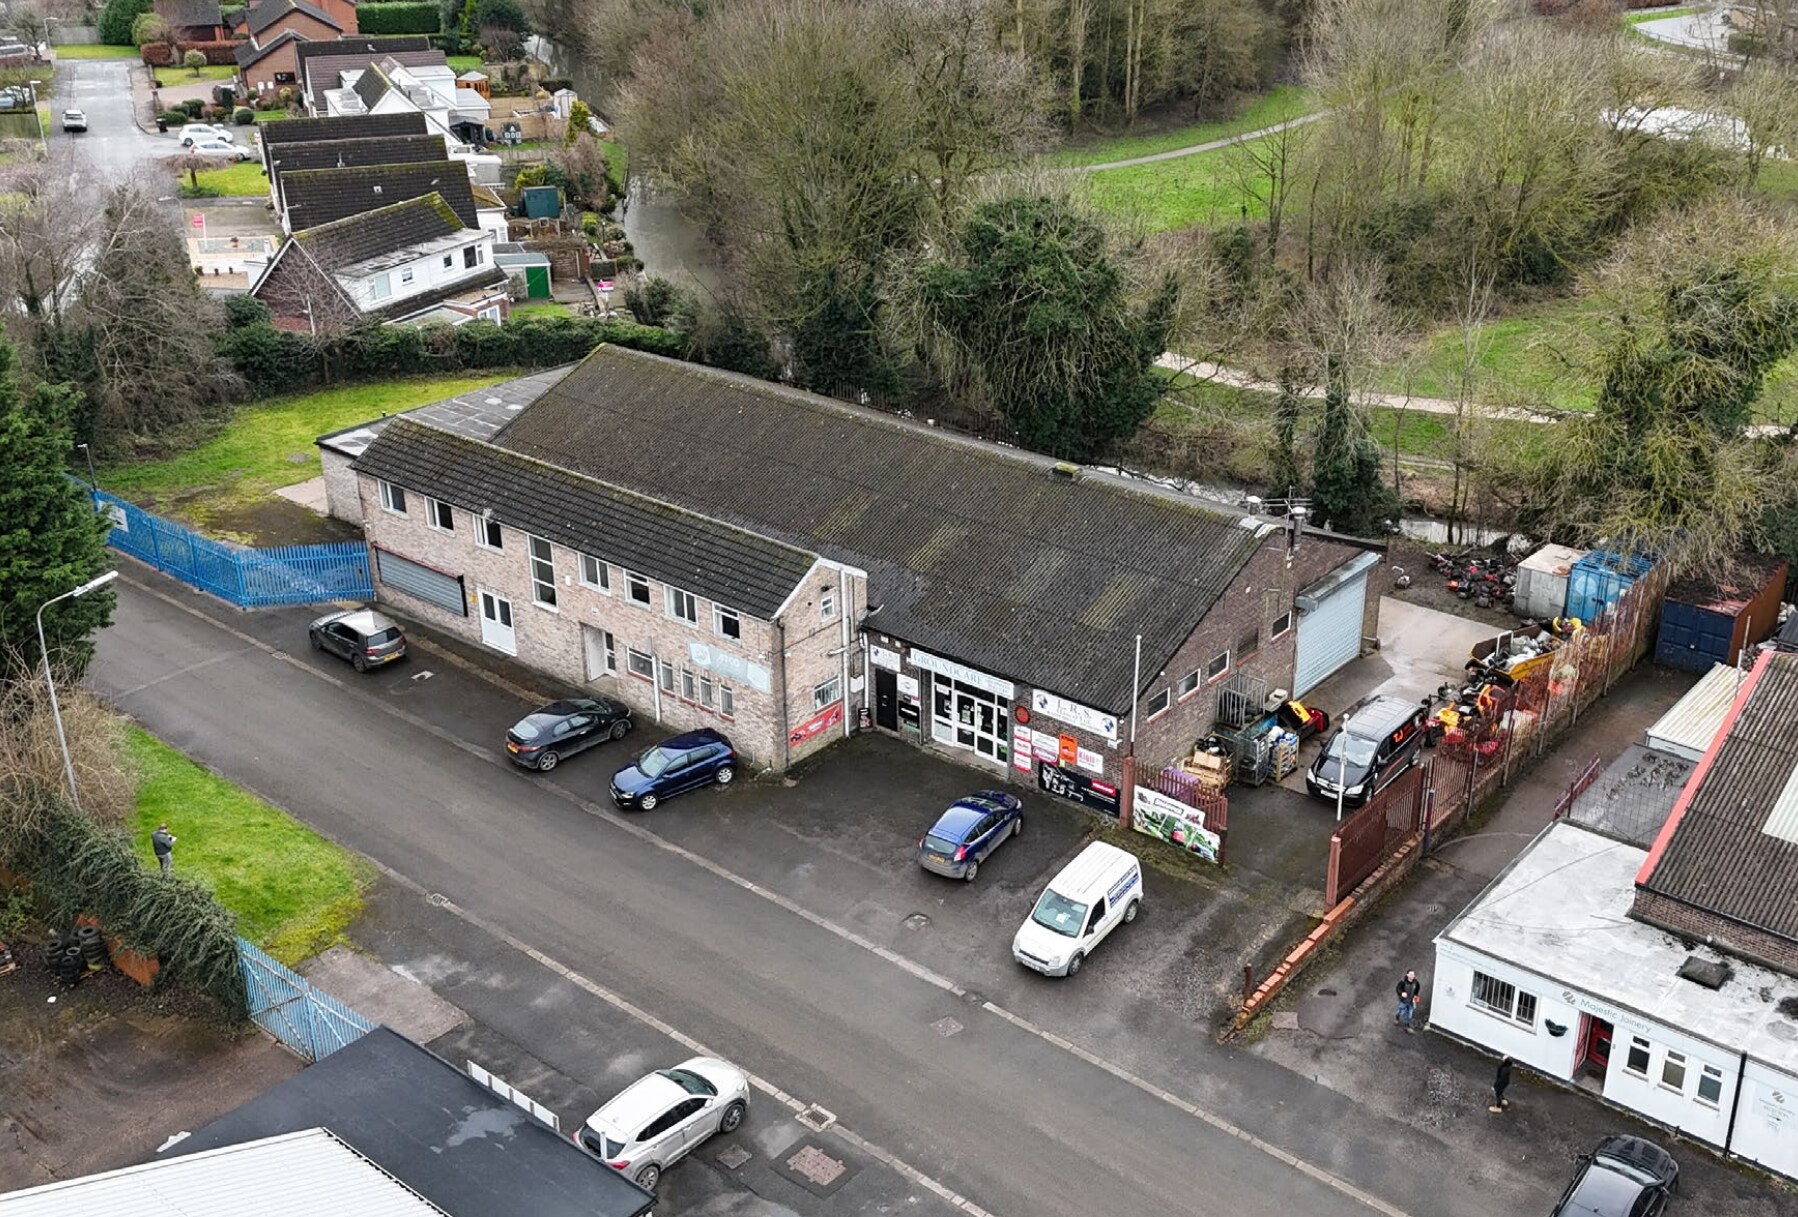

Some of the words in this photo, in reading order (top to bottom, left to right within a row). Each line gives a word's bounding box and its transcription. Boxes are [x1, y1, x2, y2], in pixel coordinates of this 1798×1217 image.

[913, 653, 981, 685] GROUNDCARE
[1580, 998, 1617, 1019] Majestic
[1620, 1014, 1652, 1033] Joinery
